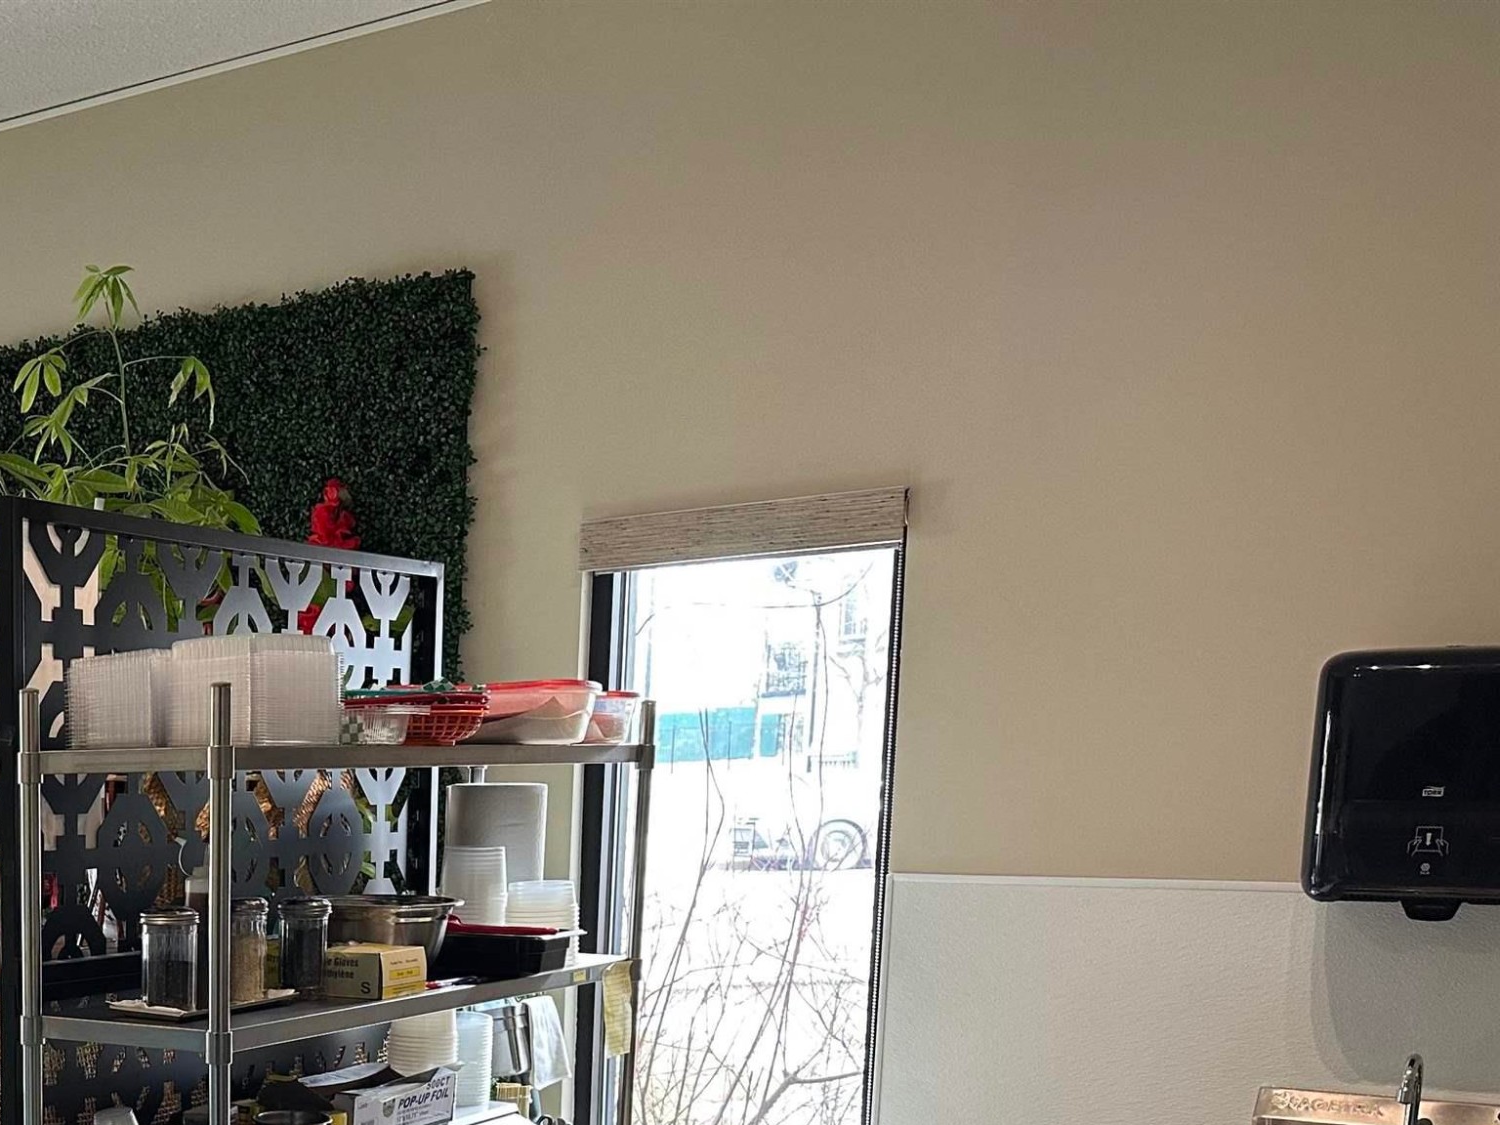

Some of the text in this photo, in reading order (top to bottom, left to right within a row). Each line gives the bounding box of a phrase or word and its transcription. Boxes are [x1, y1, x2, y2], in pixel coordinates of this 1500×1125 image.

[334, 957, 359, 967] Gloves
[360, 981, 371, 995] S
[397, 1092, 431, 1110] POP-UP
[430, 1087, 449, 1103] FOIL
